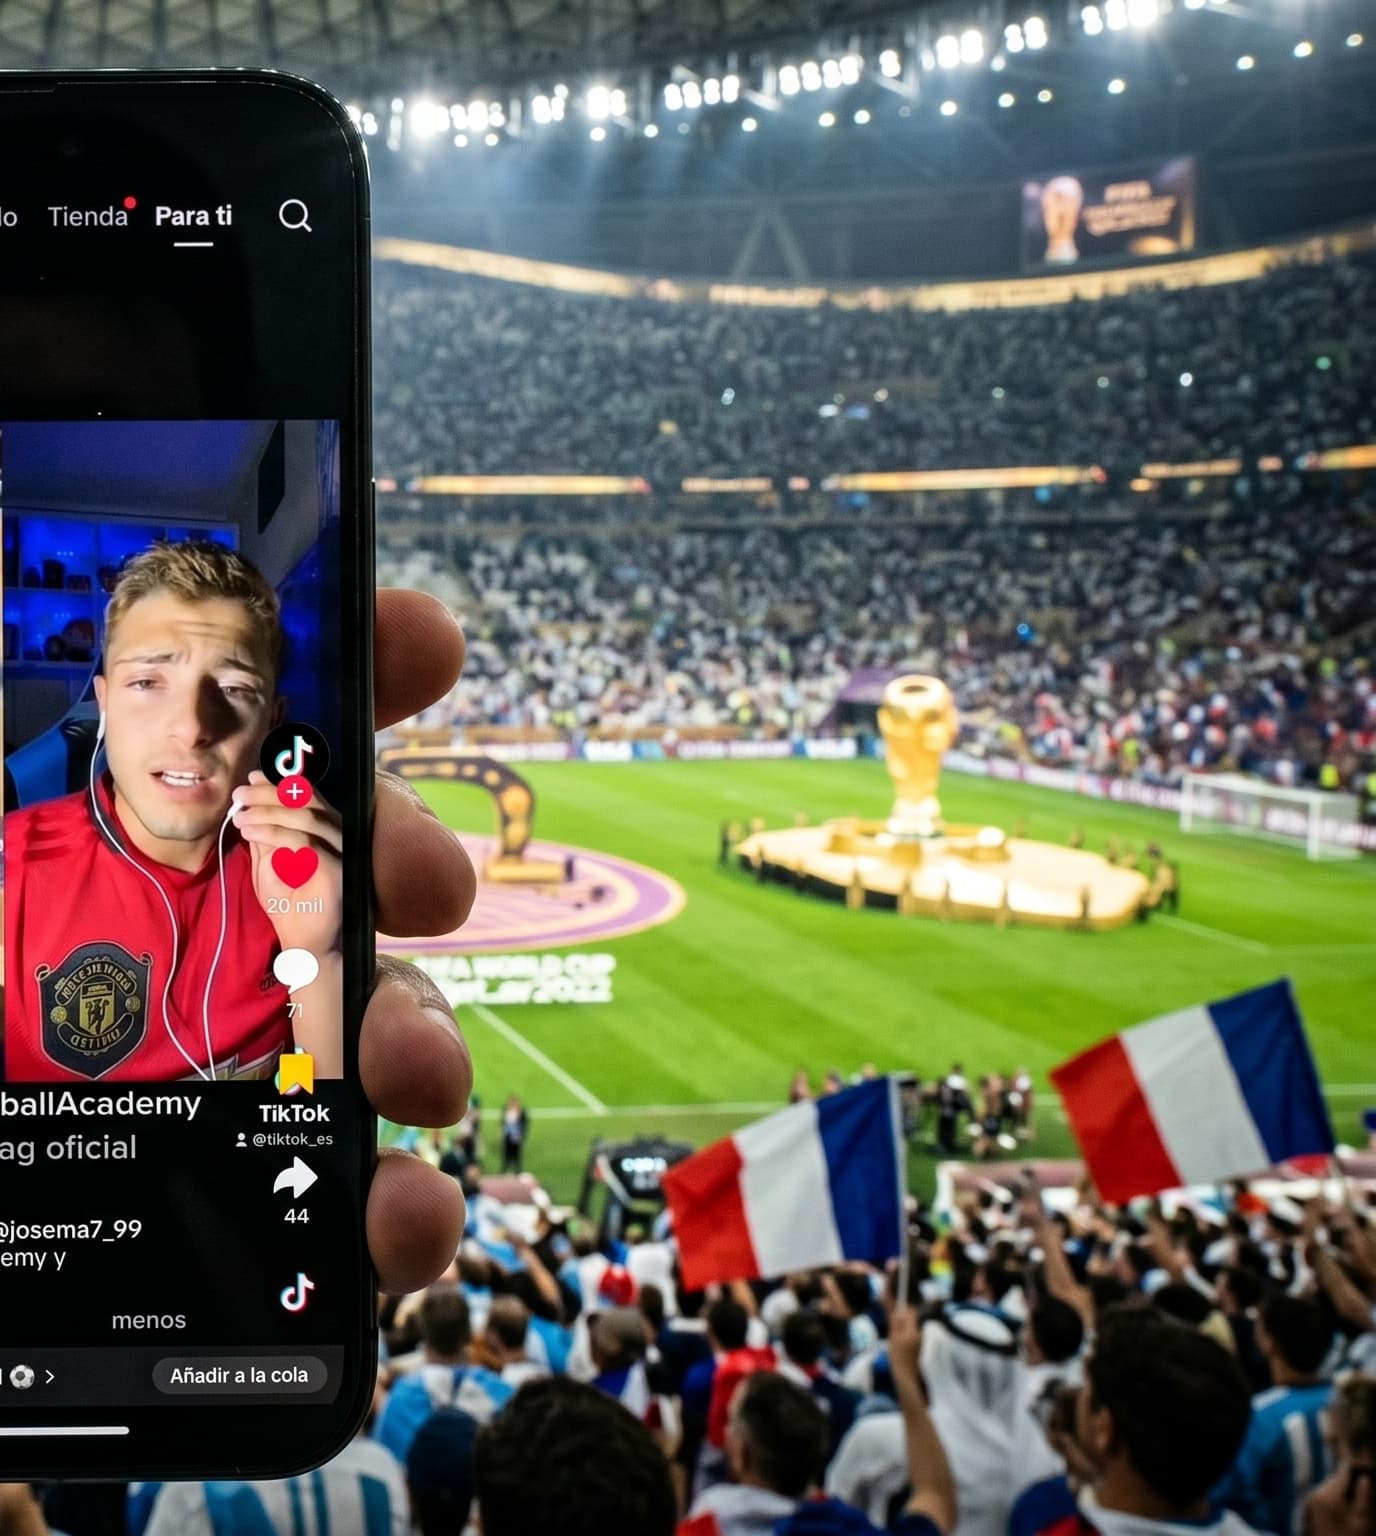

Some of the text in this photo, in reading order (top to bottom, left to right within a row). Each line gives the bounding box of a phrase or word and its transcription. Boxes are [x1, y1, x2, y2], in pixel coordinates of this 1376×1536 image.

[47, 206, 129, 227] Tienda
[156, 203, 232, 227] Para ti
[267, 896, 322, 913] 20 mil
[286, 1003, 303, 1018] 71
[259, 1104, 331, 1122] TikTok
[46, 1133, 136, 1160] oficial
[252, 1132, 334, 1147] @tiktok_es
[284, 1208, 310, 1224] 44
[53, 1252, 67, 1272] y
[112, 1314, 187, 1330] menos
[170, 1366, 309, 1384] Añadir a la cola
